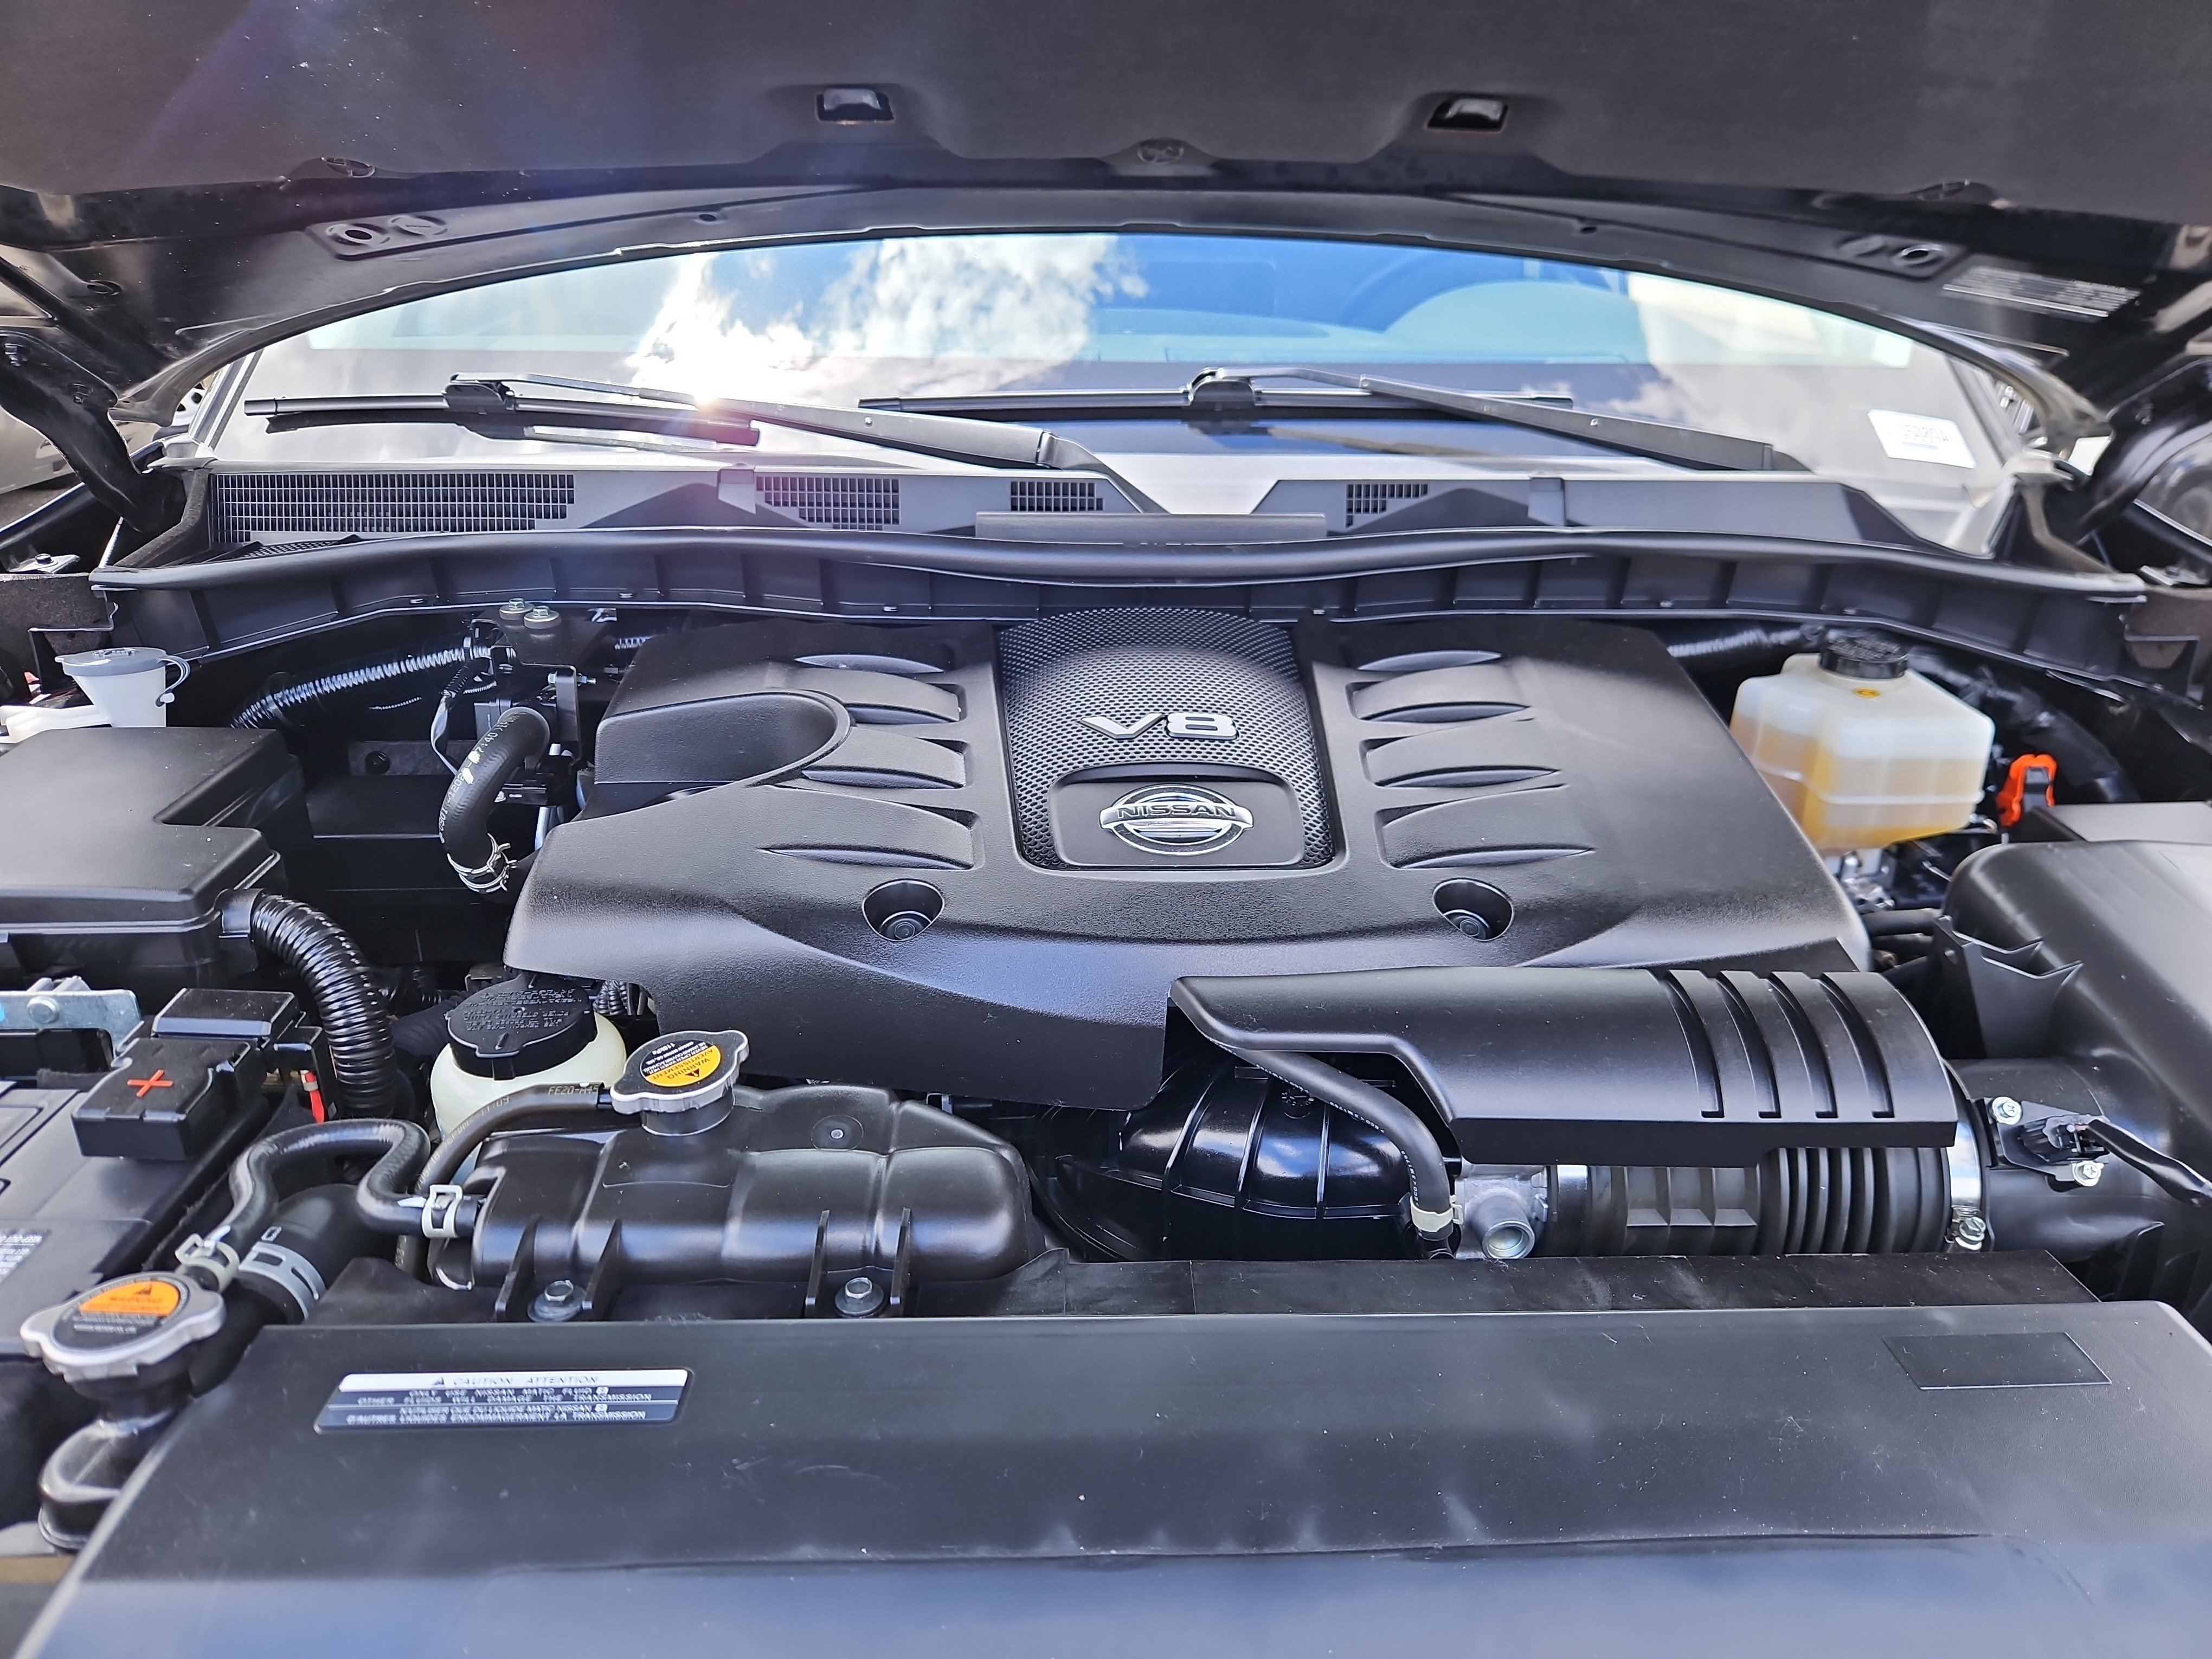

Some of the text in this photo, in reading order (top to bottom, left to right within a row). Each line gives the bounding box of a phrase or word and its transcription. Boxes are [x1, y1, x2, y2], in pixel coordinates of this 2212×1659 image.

[1080, 712, 1238, 741] V8
[1117, 804, 1237, 819] NISSAN
[653, 1049, 713, 1079] AVERTISSEMENT
[667, 1058, 710, 1079] WARNING
[573, 1393, 652, 1402] TRANSMISSION
